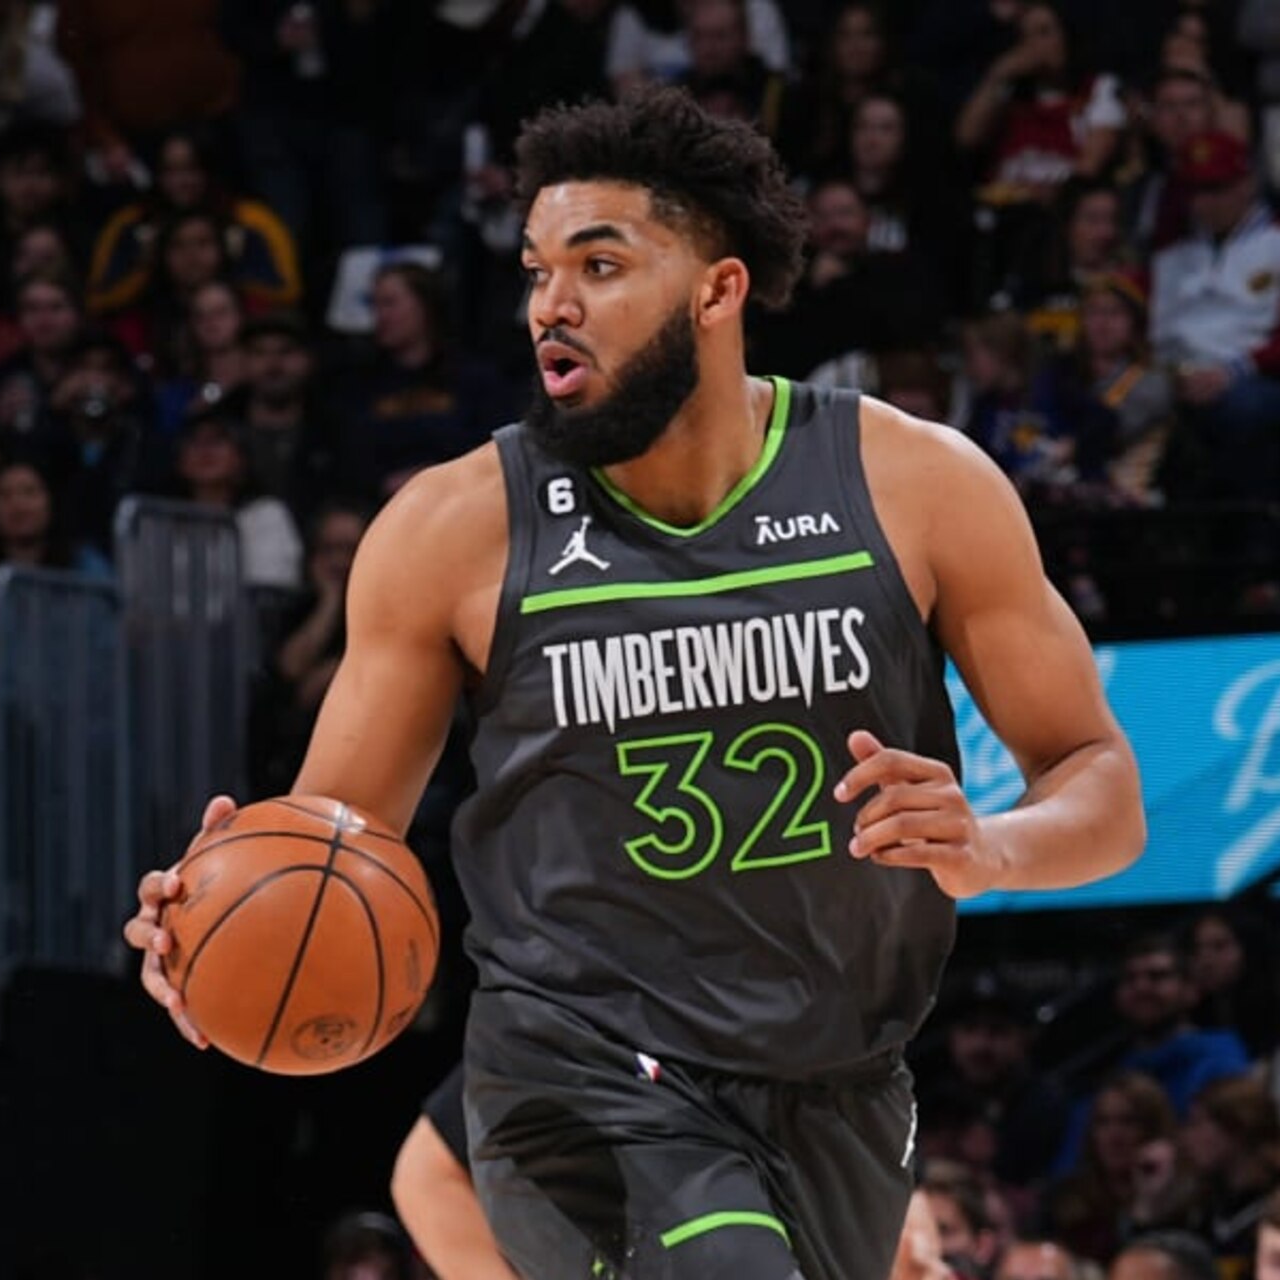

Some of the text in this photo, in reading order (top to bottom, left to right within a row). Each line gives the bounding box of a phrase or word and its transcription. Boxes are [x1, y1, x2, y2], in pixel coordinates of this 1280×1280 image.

[547, 477, 575, 514] 6
[542, 606, 872, 735] TIMBERWOLVES
[616, 722, 832, 880] 32
